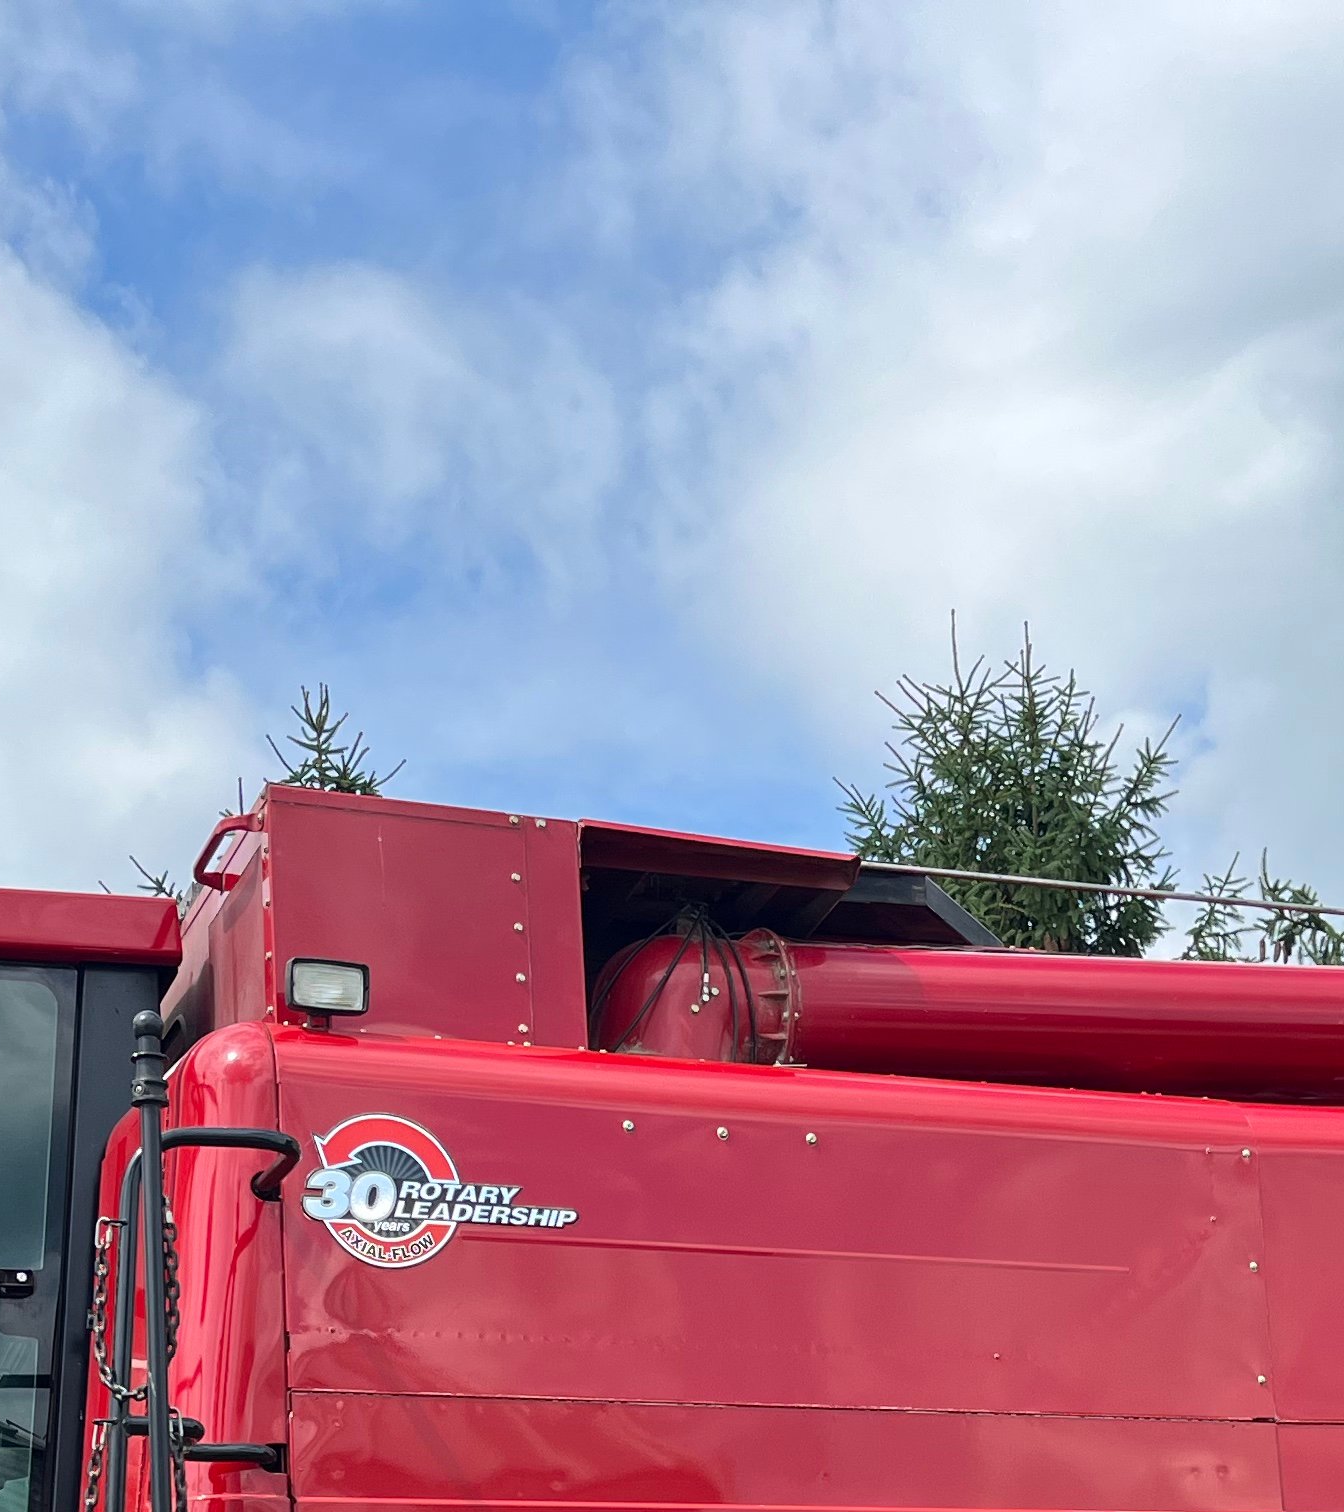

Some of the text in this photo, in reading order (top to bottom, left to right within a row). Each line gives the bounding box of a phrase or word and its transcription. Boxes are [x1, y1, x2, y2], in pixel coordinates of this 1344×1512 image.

[302, 1168, 397, 1221] 30
[399, 1180, 521, 1206] ROTARY
[372, 1218, 411, 1233] years
[393, 1200, 578, 1229] LEADERSHIP
